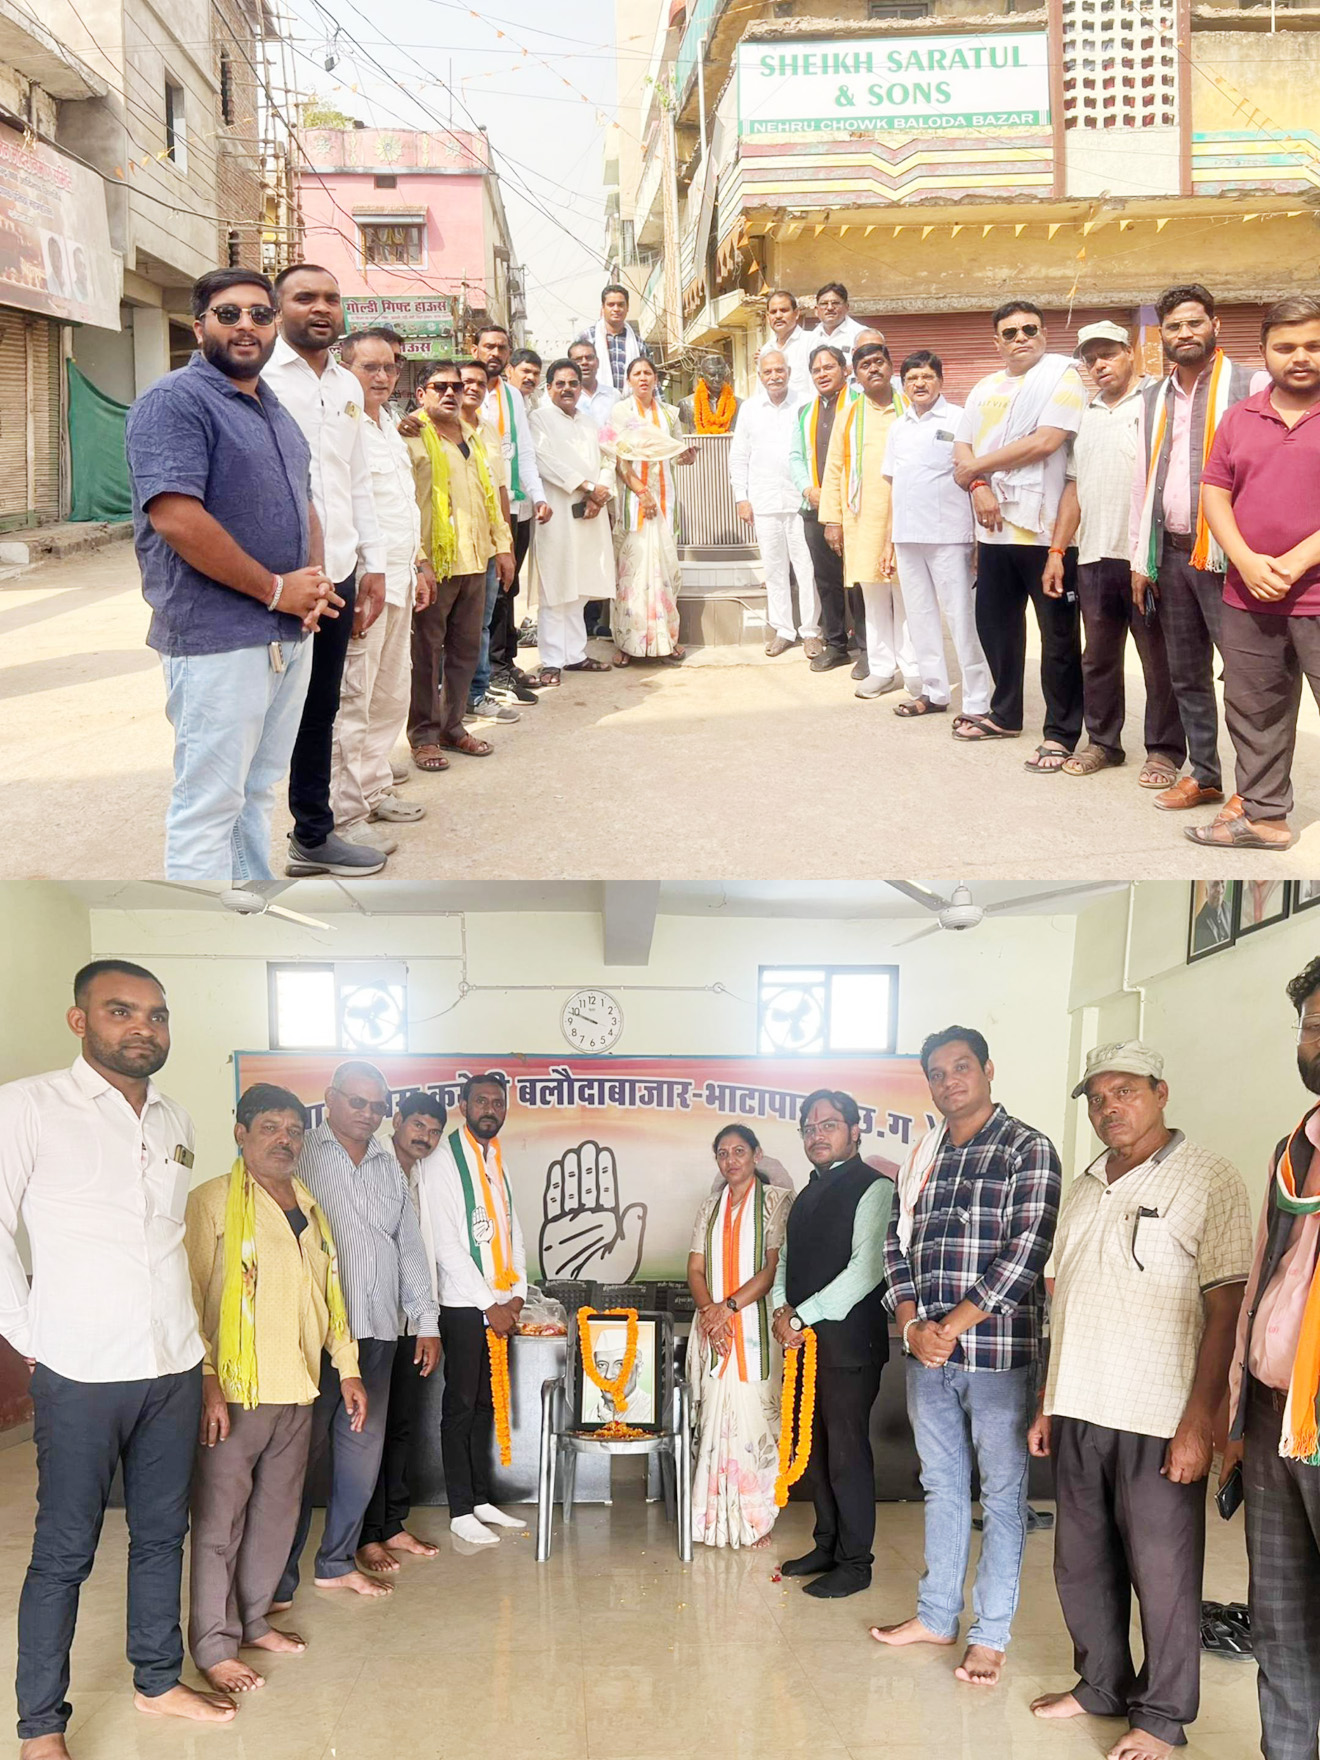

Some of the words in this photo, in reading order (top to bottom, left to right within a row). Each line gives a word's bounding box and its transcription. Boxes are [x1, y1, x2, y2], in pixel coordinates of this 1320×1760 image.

[760, 52, 873, 77] SHEIKH
[887, 45, 1028, 73] SARATUL
[834, 84, 856, 107] &
[868, 81, 952, 106] SONS
[753, 118, 815, 133] NEHRU
[821, 116, 888, 131] CHOWK
[894, 115, 967, 129] BALODA
[972, 112, 1034, 126] BAZAR
[346, 300, 378, 313] गोल्डी
[381, 299, 411, 313] गिफ्ट
[414, 300, 447, 312] हाऊस
[579, 999, 586, 1008] 11
[588, 996, 596, 1005] 12
[571, 1007, 580, 1016] 10
[607, 1006, 613, 1015] 2
[567, 1017, 573, 1025] 9
[611, 1017, 617, 1026] 3
[571, 1028, 577, 1037] 8
[608, 1028, 613, 1036] 4
[580, 1035, 585, 1043] 7
[590, 1039, 595, 1047] 6
[600, 1036, 606, 1044] 5
